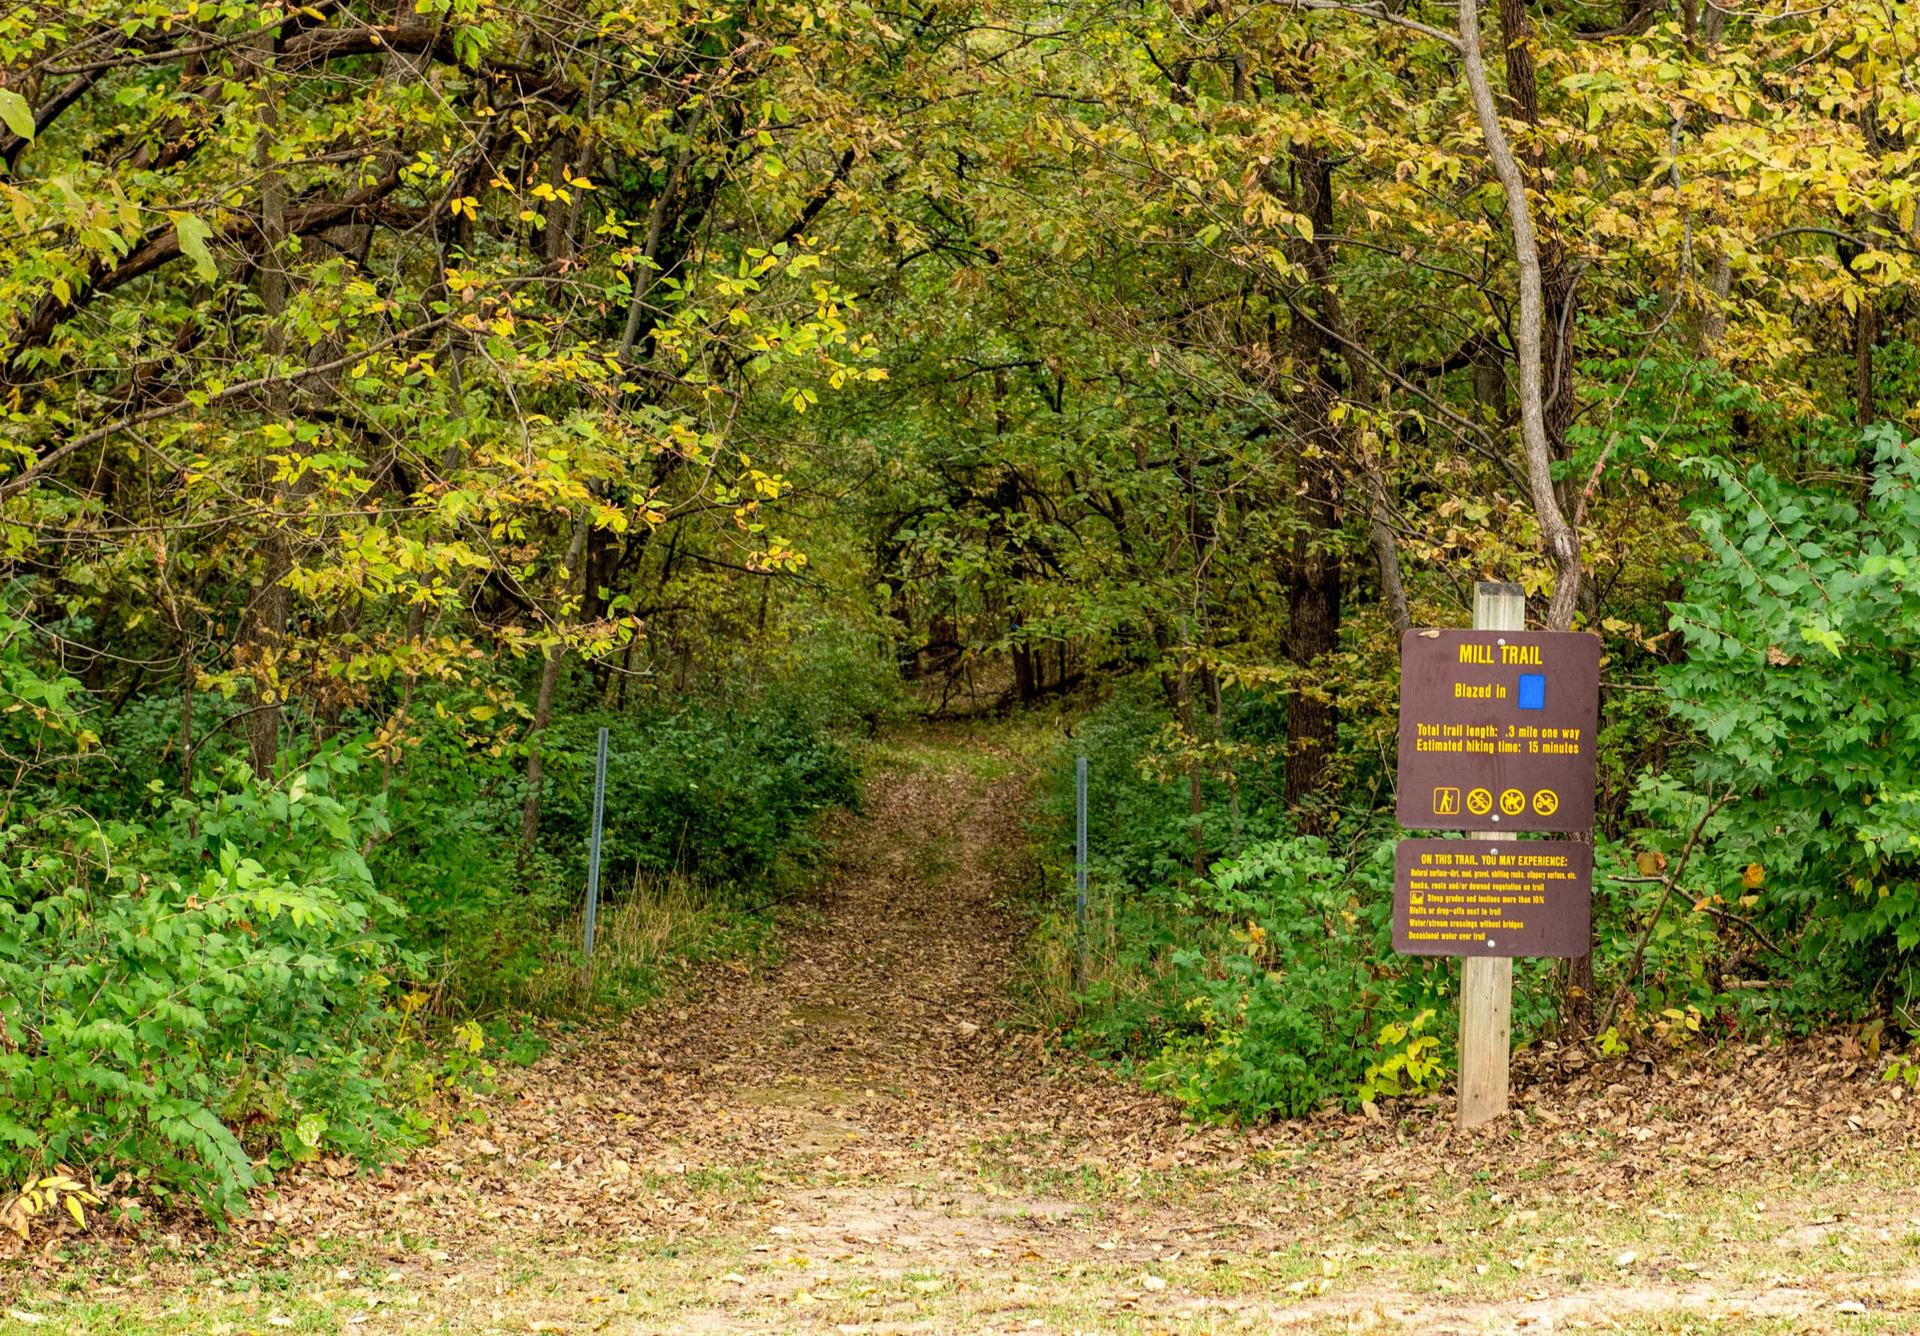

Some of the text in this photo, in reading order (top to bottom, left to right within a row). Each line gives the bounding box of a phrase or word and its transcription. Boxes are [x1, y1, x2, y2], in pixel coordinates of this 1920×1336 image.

[1459, 644, 1543, 664] MILL TRAIL
[1454, 683, 1506, 698] Blazed in
[1417, 723, 1580, 740] Total trail length: .3 mile one way
[1416, 739, 1579, 754] Estimated hiking time: 15 minutes
[1421, 854, 1432, 865] ON
[1434, 854, 1452, 865] THIS
[1481, 855, 1497, 865] YOU
[1499, 855, 1515, 866] MAY
[1518, 855, 1568, 867] EXPERIENCE:
[1410, 868, 1428, 877] Natural
[1527, 870, 1546, 880] slippery
[1410, 881, 1430, 890] Rocks,
[1431, 882, 1446, 890] roots
[1449, 882, 1467, 890] and/or
[1492, 883, 1521, 892] vegetation
[1532, 883, 1544, 891] trail
[1427, 893, 1443, 903] Steep
[1445, 894, 1464, 904] grades
[1466, 894, 1477, 903] and
[1478, 894, 1500, 903] inclines
[1518, 895, 1531, 904] than
[1532, 895, 1545, 904] 10%
[1409, 905, 1427, 915] Bluffs
[1428, 907, 1435, 915] or
[1466, 907, 1479, 915] next
[1481, 907, 1487, 915] to
[1489, 907, 1502, 916] trail
[1409, 918, 1524, 929] Water/stream crossings without bridges
[1408, 931, 1440, 940] Occasional
[1441, 932, 1457, 940] water
[1473, 932, 1486, 941] trail
